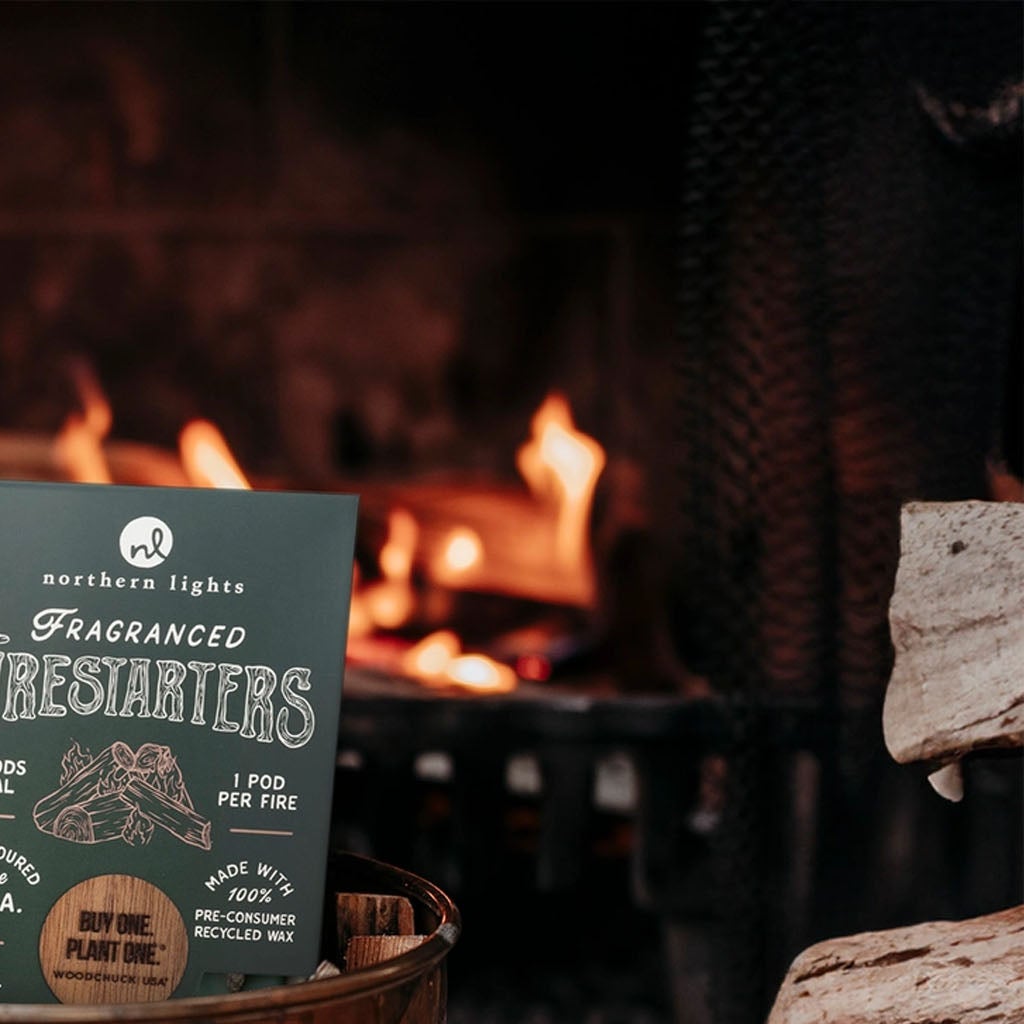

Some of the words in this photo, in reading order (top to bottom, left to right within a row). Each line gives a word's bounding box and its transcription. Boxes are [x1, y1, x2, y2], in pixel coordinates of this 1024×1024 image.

[42, 571, 156, 590] northern
[169, 575, 245, 597] lights
[31, 607, 246, 649] FRAGRANCED
[233, 772, 240, 788] 1
[247, 773, 286, 791] POD
[218, 791, 252, 808] PER
[260, 794, 298, 811] FIRE
[204, 861, 249, 892] MADE
[257, 862, 295, 897] WITH
[228, 887, 273, 904] 100%
[79, 910, 114, 934] BUY
[116, 913, 154, 937] ONE.
[194, 908, 296, 926] PRE-CONSUMER
[194, 925, 262, 941] RECYCLED
[267, 930, 294, 943] WAX
[66, 938, 121, 963] PLANT
[53, 970, 137, 984] WOODCHUCK
